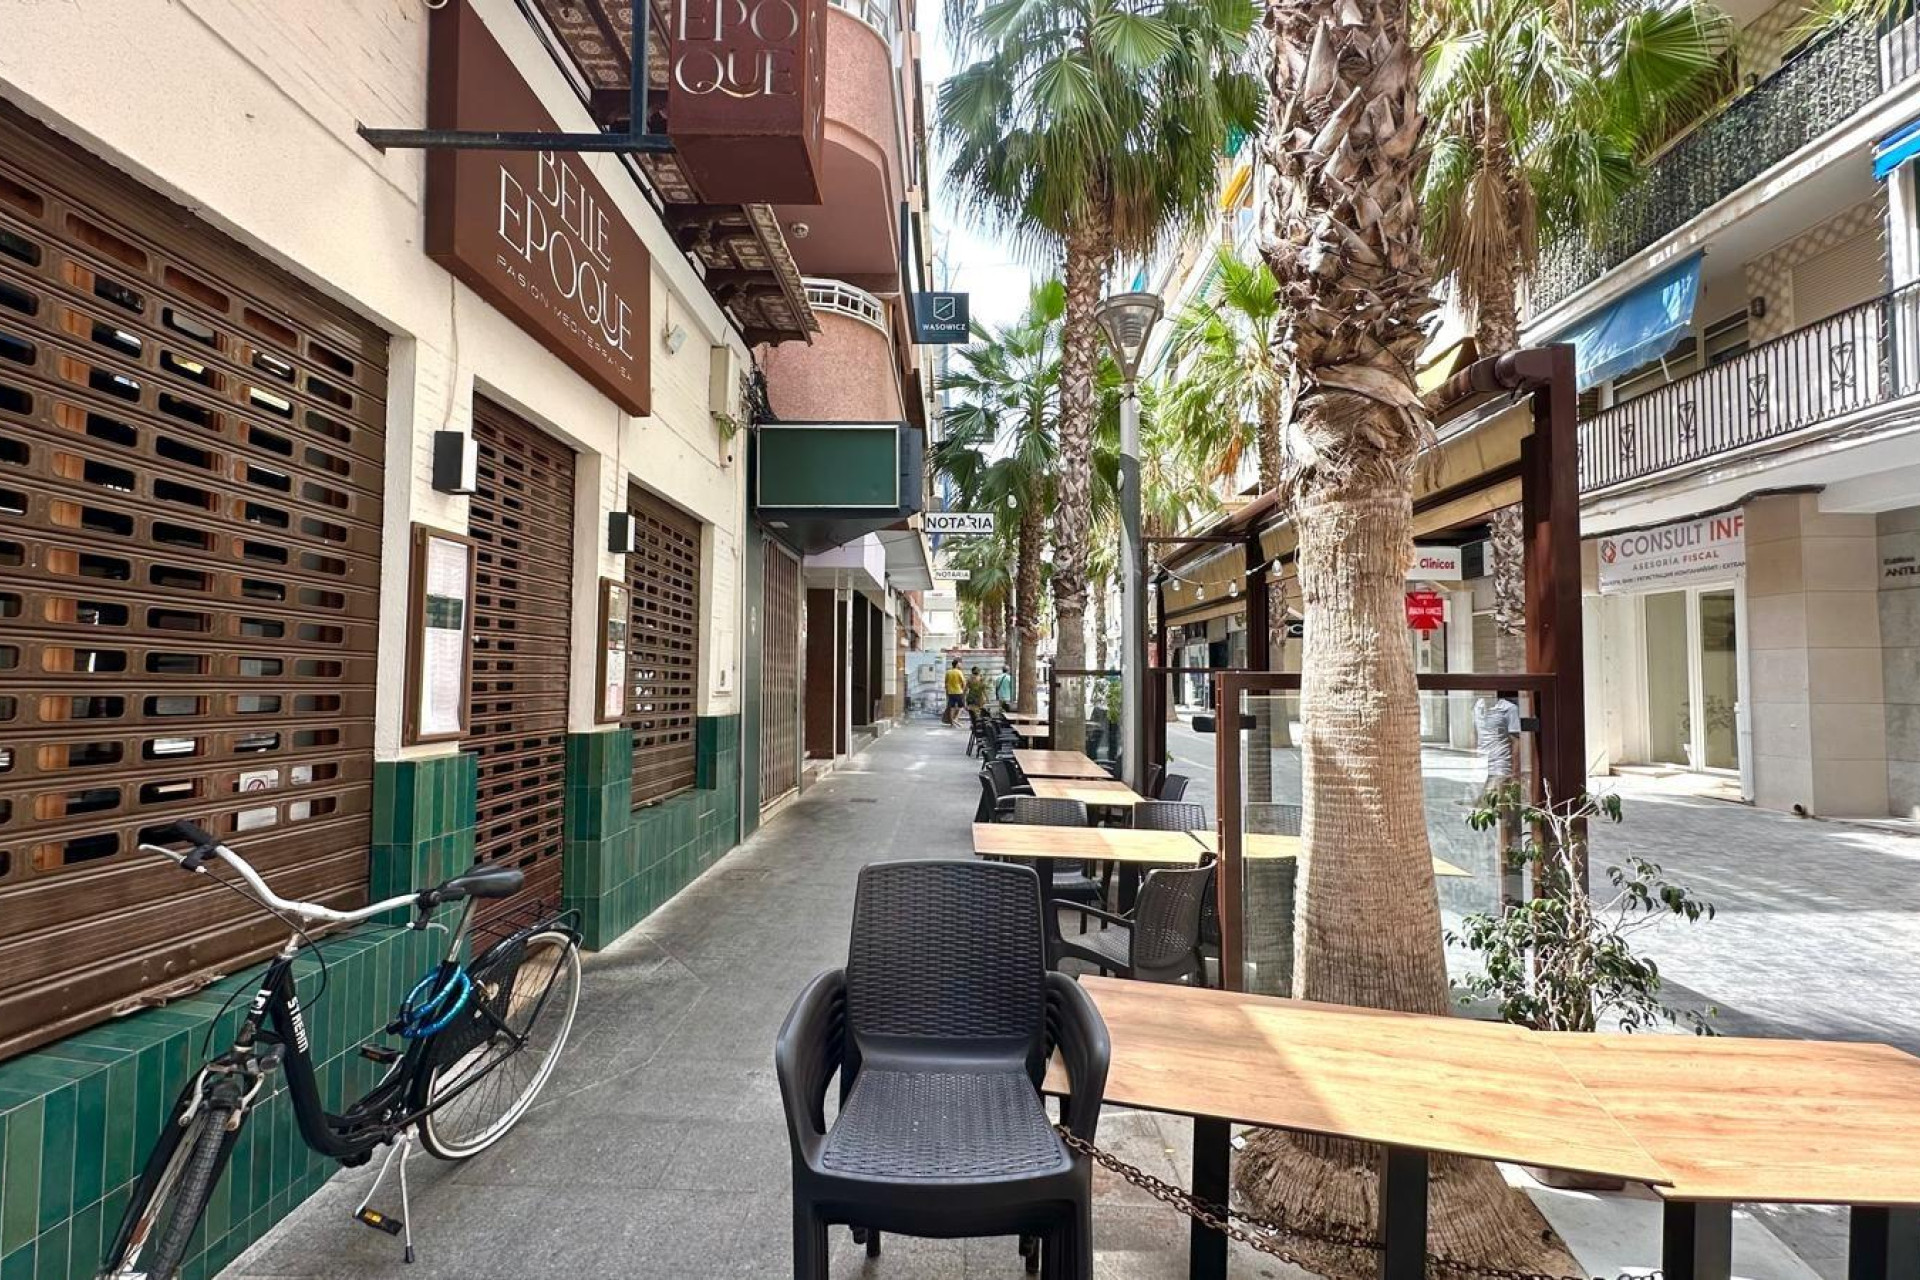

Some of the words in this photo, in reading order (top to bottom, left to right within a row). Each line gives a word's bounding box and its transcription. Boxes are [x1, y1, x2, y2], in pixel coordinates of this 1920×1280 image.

[675, 49, 798, 98] QUE
[537, 127, 612, 272] BELLE
[499, 163, 634, 362] EPOQUE
[922, 323, 966, 331] WASOWICZ
[927, 515, 993, 529] NOTARIA
[1621, 523, 1703, 557] CONSULT
[1683, 550, 1719, 563] FISCAL
[287, 996, 309, 1054] STREAM
